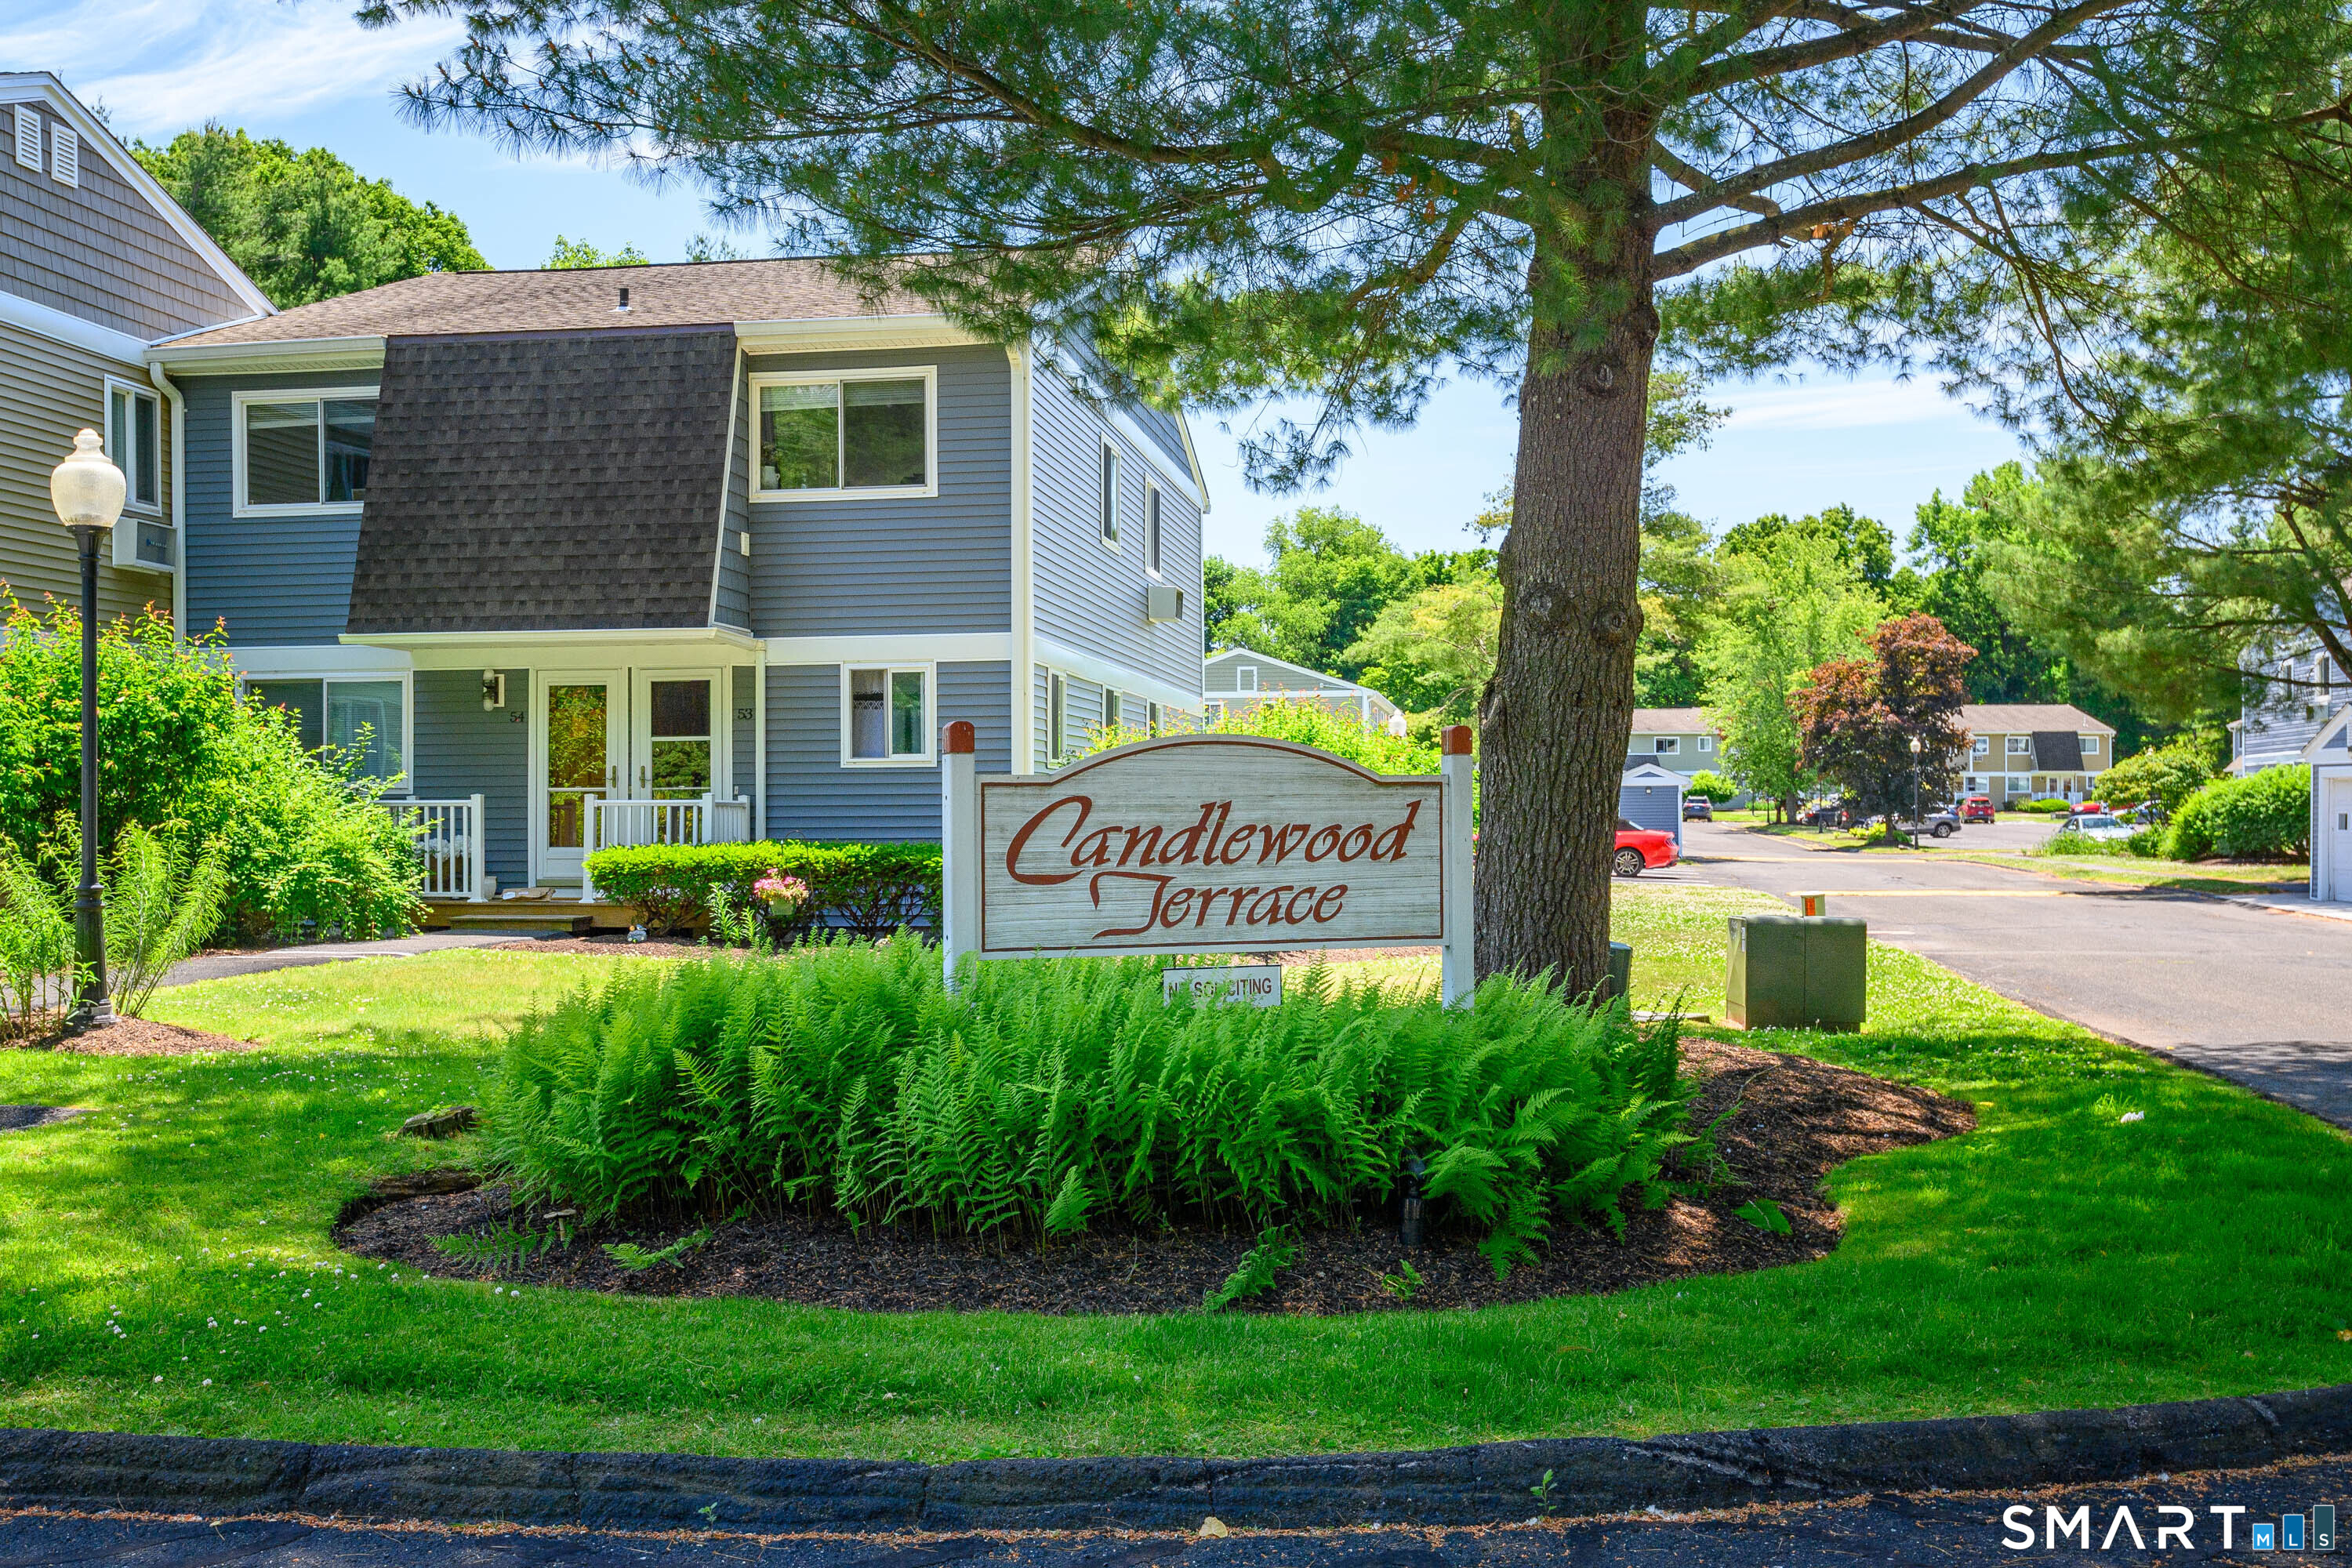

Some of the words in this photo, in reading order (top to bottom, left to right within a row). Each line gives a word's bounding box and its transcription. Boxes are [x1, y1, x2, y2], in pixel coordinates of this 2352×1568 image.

[510, 711, 524, 722] 54
[737, 708, 753, 720] 53
[1007, 796, 1421, 884] Candlewood
[1090, 871, 1348, 938] Terrace
[1168, 982, 1188, 999] N
